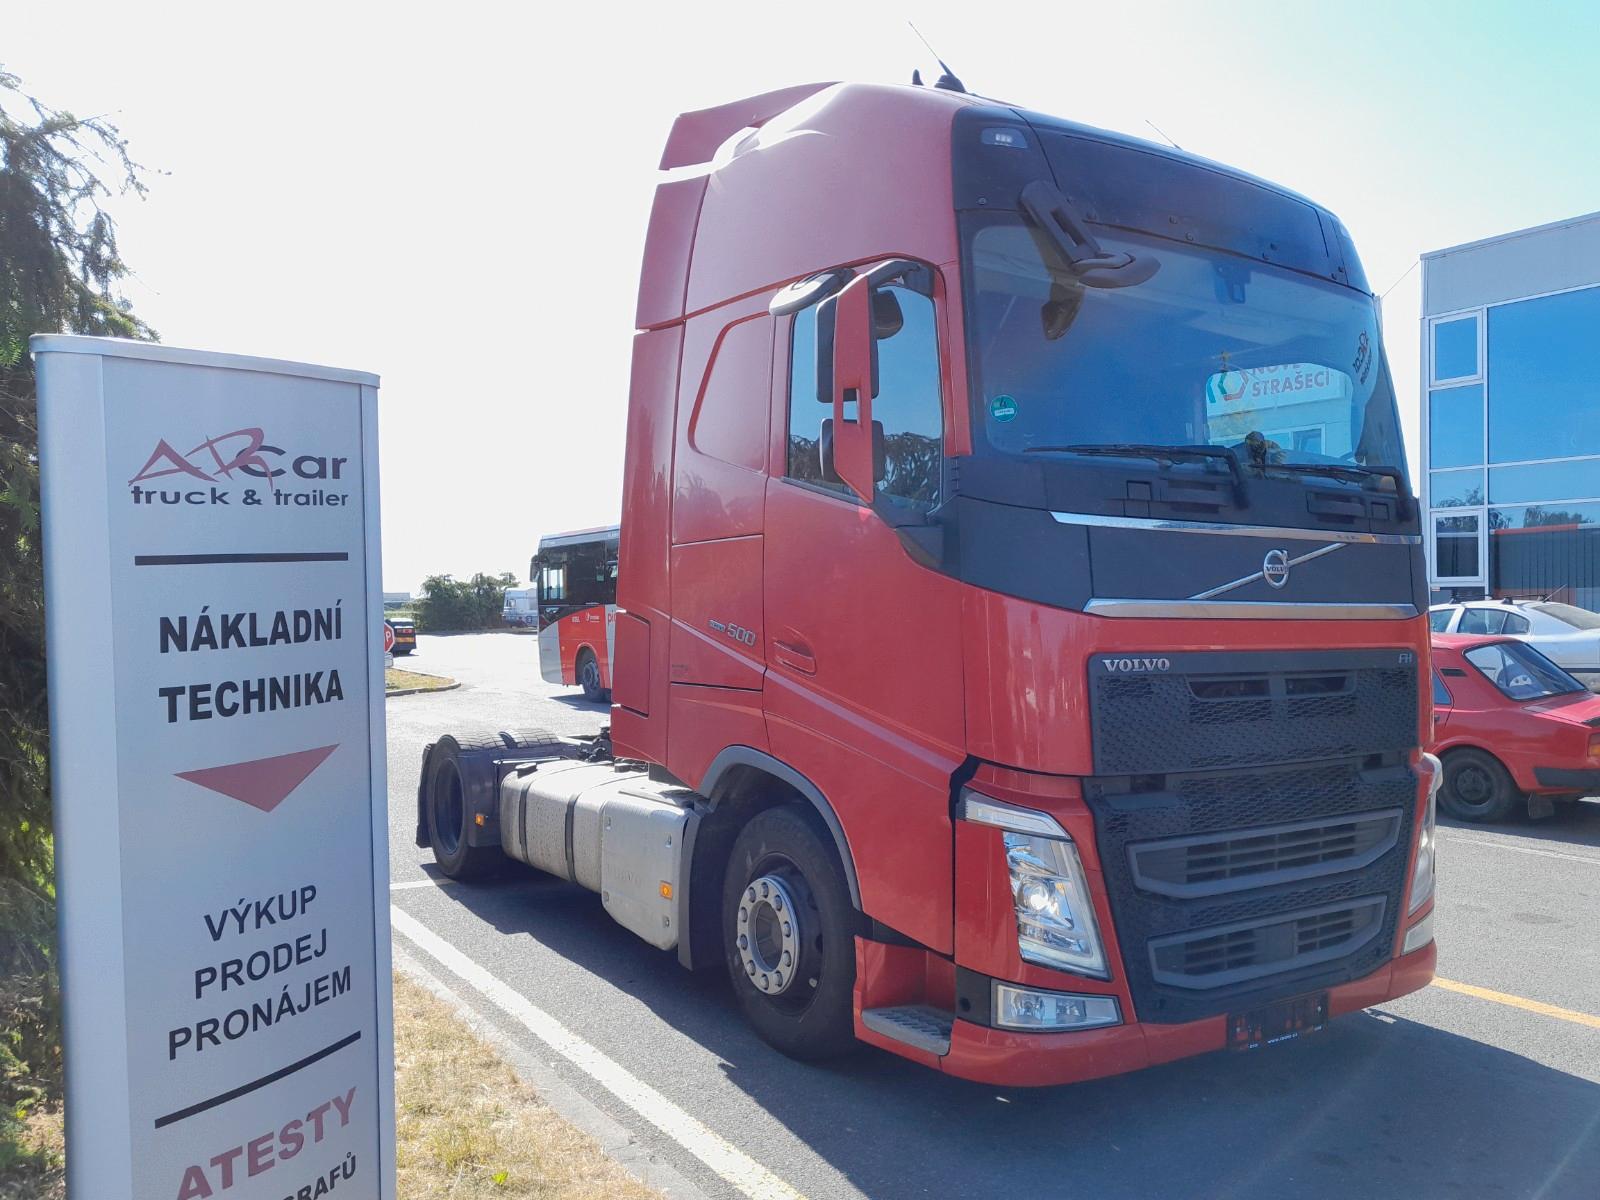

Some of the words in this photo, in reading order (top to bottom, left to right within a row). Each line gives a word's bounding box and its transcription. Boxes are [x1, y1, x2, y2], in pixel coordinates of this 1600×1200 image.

[131, 486, 230, 505] truck
[242, 489, 263, 506] &
[273, 489, 349, 507] trailer
[160, 599, 343, 653] NÁKLADNÍ
[727, 622, 756, 647] 500
[1102, 658, 1170, 672] VOLVO
[158, 670, 344, 723] TECHNIKA
[204, 885, 317, 941] VÝKUP
[194, 929, 328, 1000] PRODEJ
[169, 966, 351, 1061] PRONÁJEM
[177, 1086, 357, 1200] ATESTY
